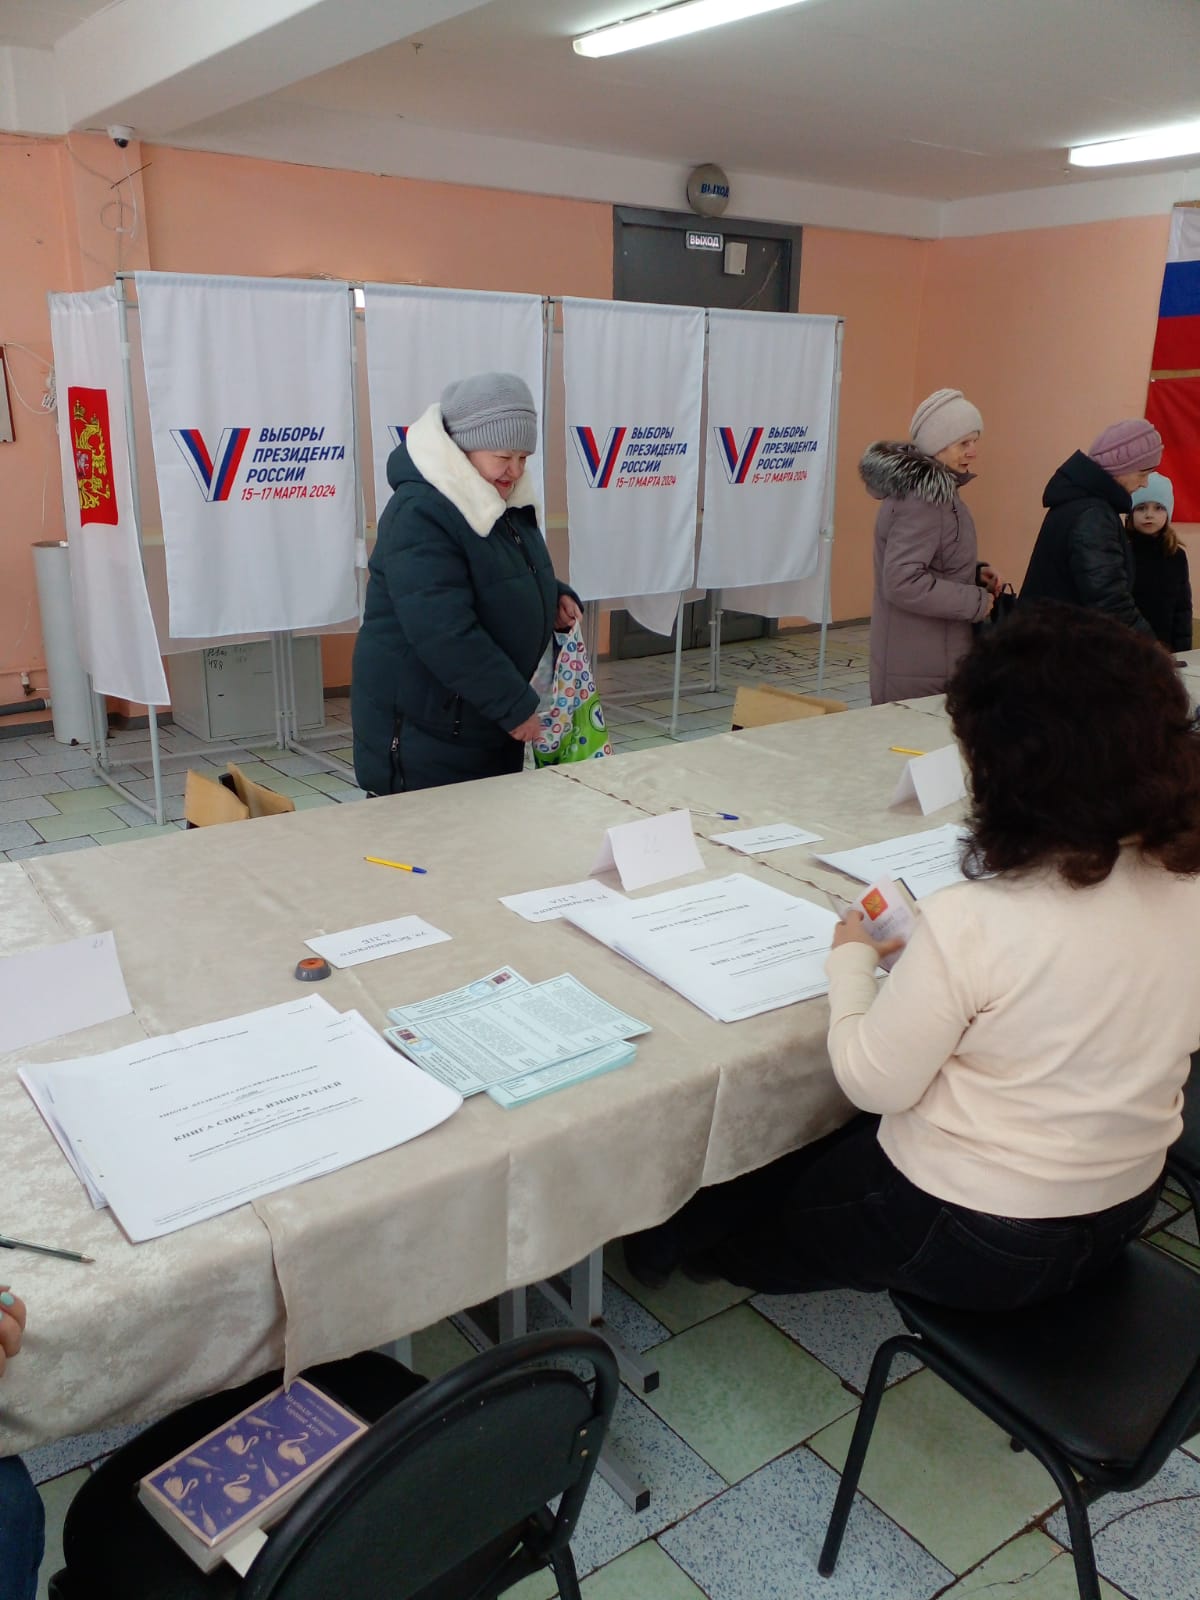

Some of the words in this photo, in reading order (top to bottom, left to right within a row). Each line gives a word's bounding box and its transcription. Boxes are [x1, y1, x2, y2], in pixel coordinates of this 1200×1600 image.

[690, 235, 719, 247] ВЫХОД
[259, 427, 325, 443] ВЫБОРЫ
[631, 426, 675, 440] ВЫБОРЫ
[768, 426, 808, 438] ВЫБОРЫ
[252, 446, 345, 463] ПРЕЗИДЕНТА
[625, 443, 688, 457] ПРЕЗИДЕНТА
[761, 440, 818, 455] ПРЕЗИДЕНТА
[620, 460, 662, 473] РОССИИ
[756, 458, 795, 470] РОССИИ
[246, 467, 306, 483] РОССИИ
[635, 475, 661, 487] МАРТА
[273, 485, 307, 499] МАРТА
[309, 485, 336, 498] 2024
